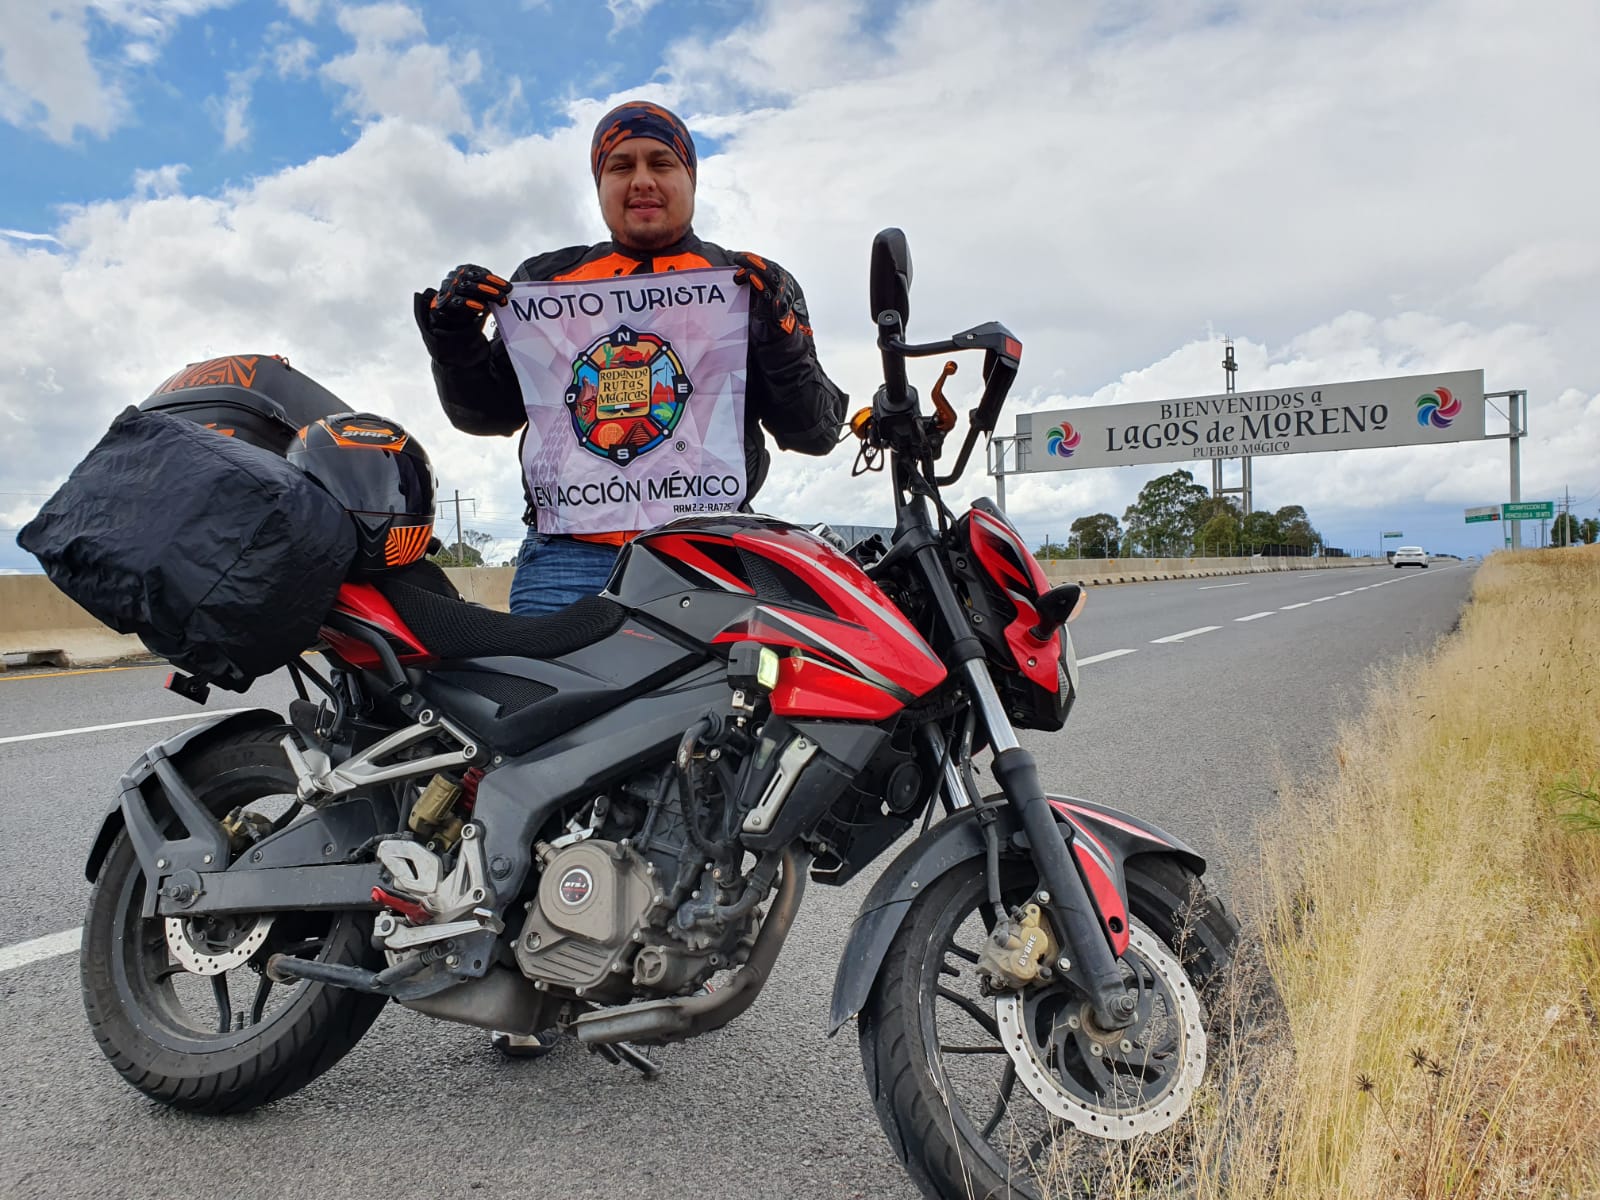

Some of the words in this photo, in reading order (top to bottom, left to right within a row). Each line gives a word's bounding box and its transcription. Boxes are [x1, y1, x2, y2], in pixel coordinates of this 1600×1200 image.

[511, 293, 604, 322] MOTO
[610, 284, 726, 314] TURISTA
[617, 332, 631, 342] N
[677, 383, 688, 394] E
[341, 430, 400, 442] SHAFT
[1206, 420, 1235, 444] de
[616, 448, 630, 460] S
[534, 486, 551, 507] EN
[557, 475, 641, 507] ACCIÓN
[648, 470, 740, 500] MÉXICO
[1018, 933, 1037, 967] BYBRE
